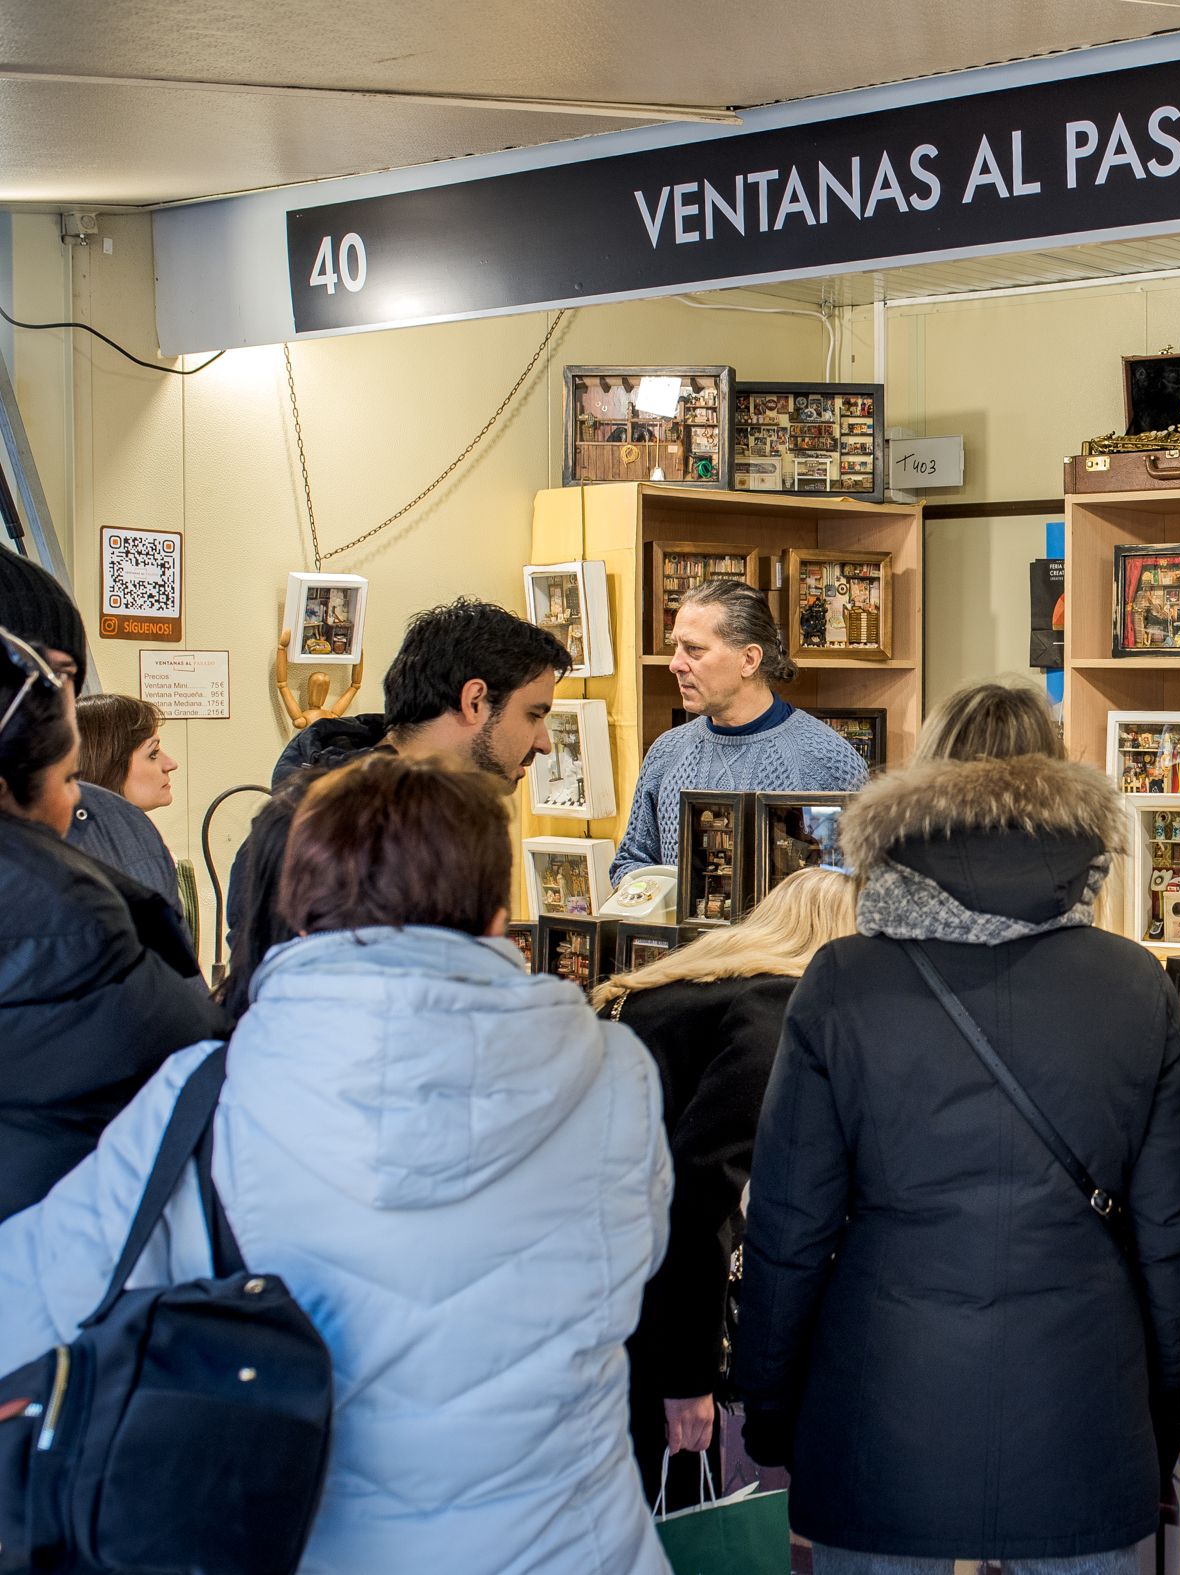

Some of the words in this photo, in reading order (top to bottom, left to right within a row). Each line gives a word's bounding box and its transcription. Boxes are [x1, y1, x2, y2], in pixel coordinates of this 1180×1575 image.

[633, 143, 941, 249] VENTANAS
[962, 130, 1041, 204] AL
[308, 231, 367, 295] 40
[124, 619, 172, 635] SÍGUENOS!
